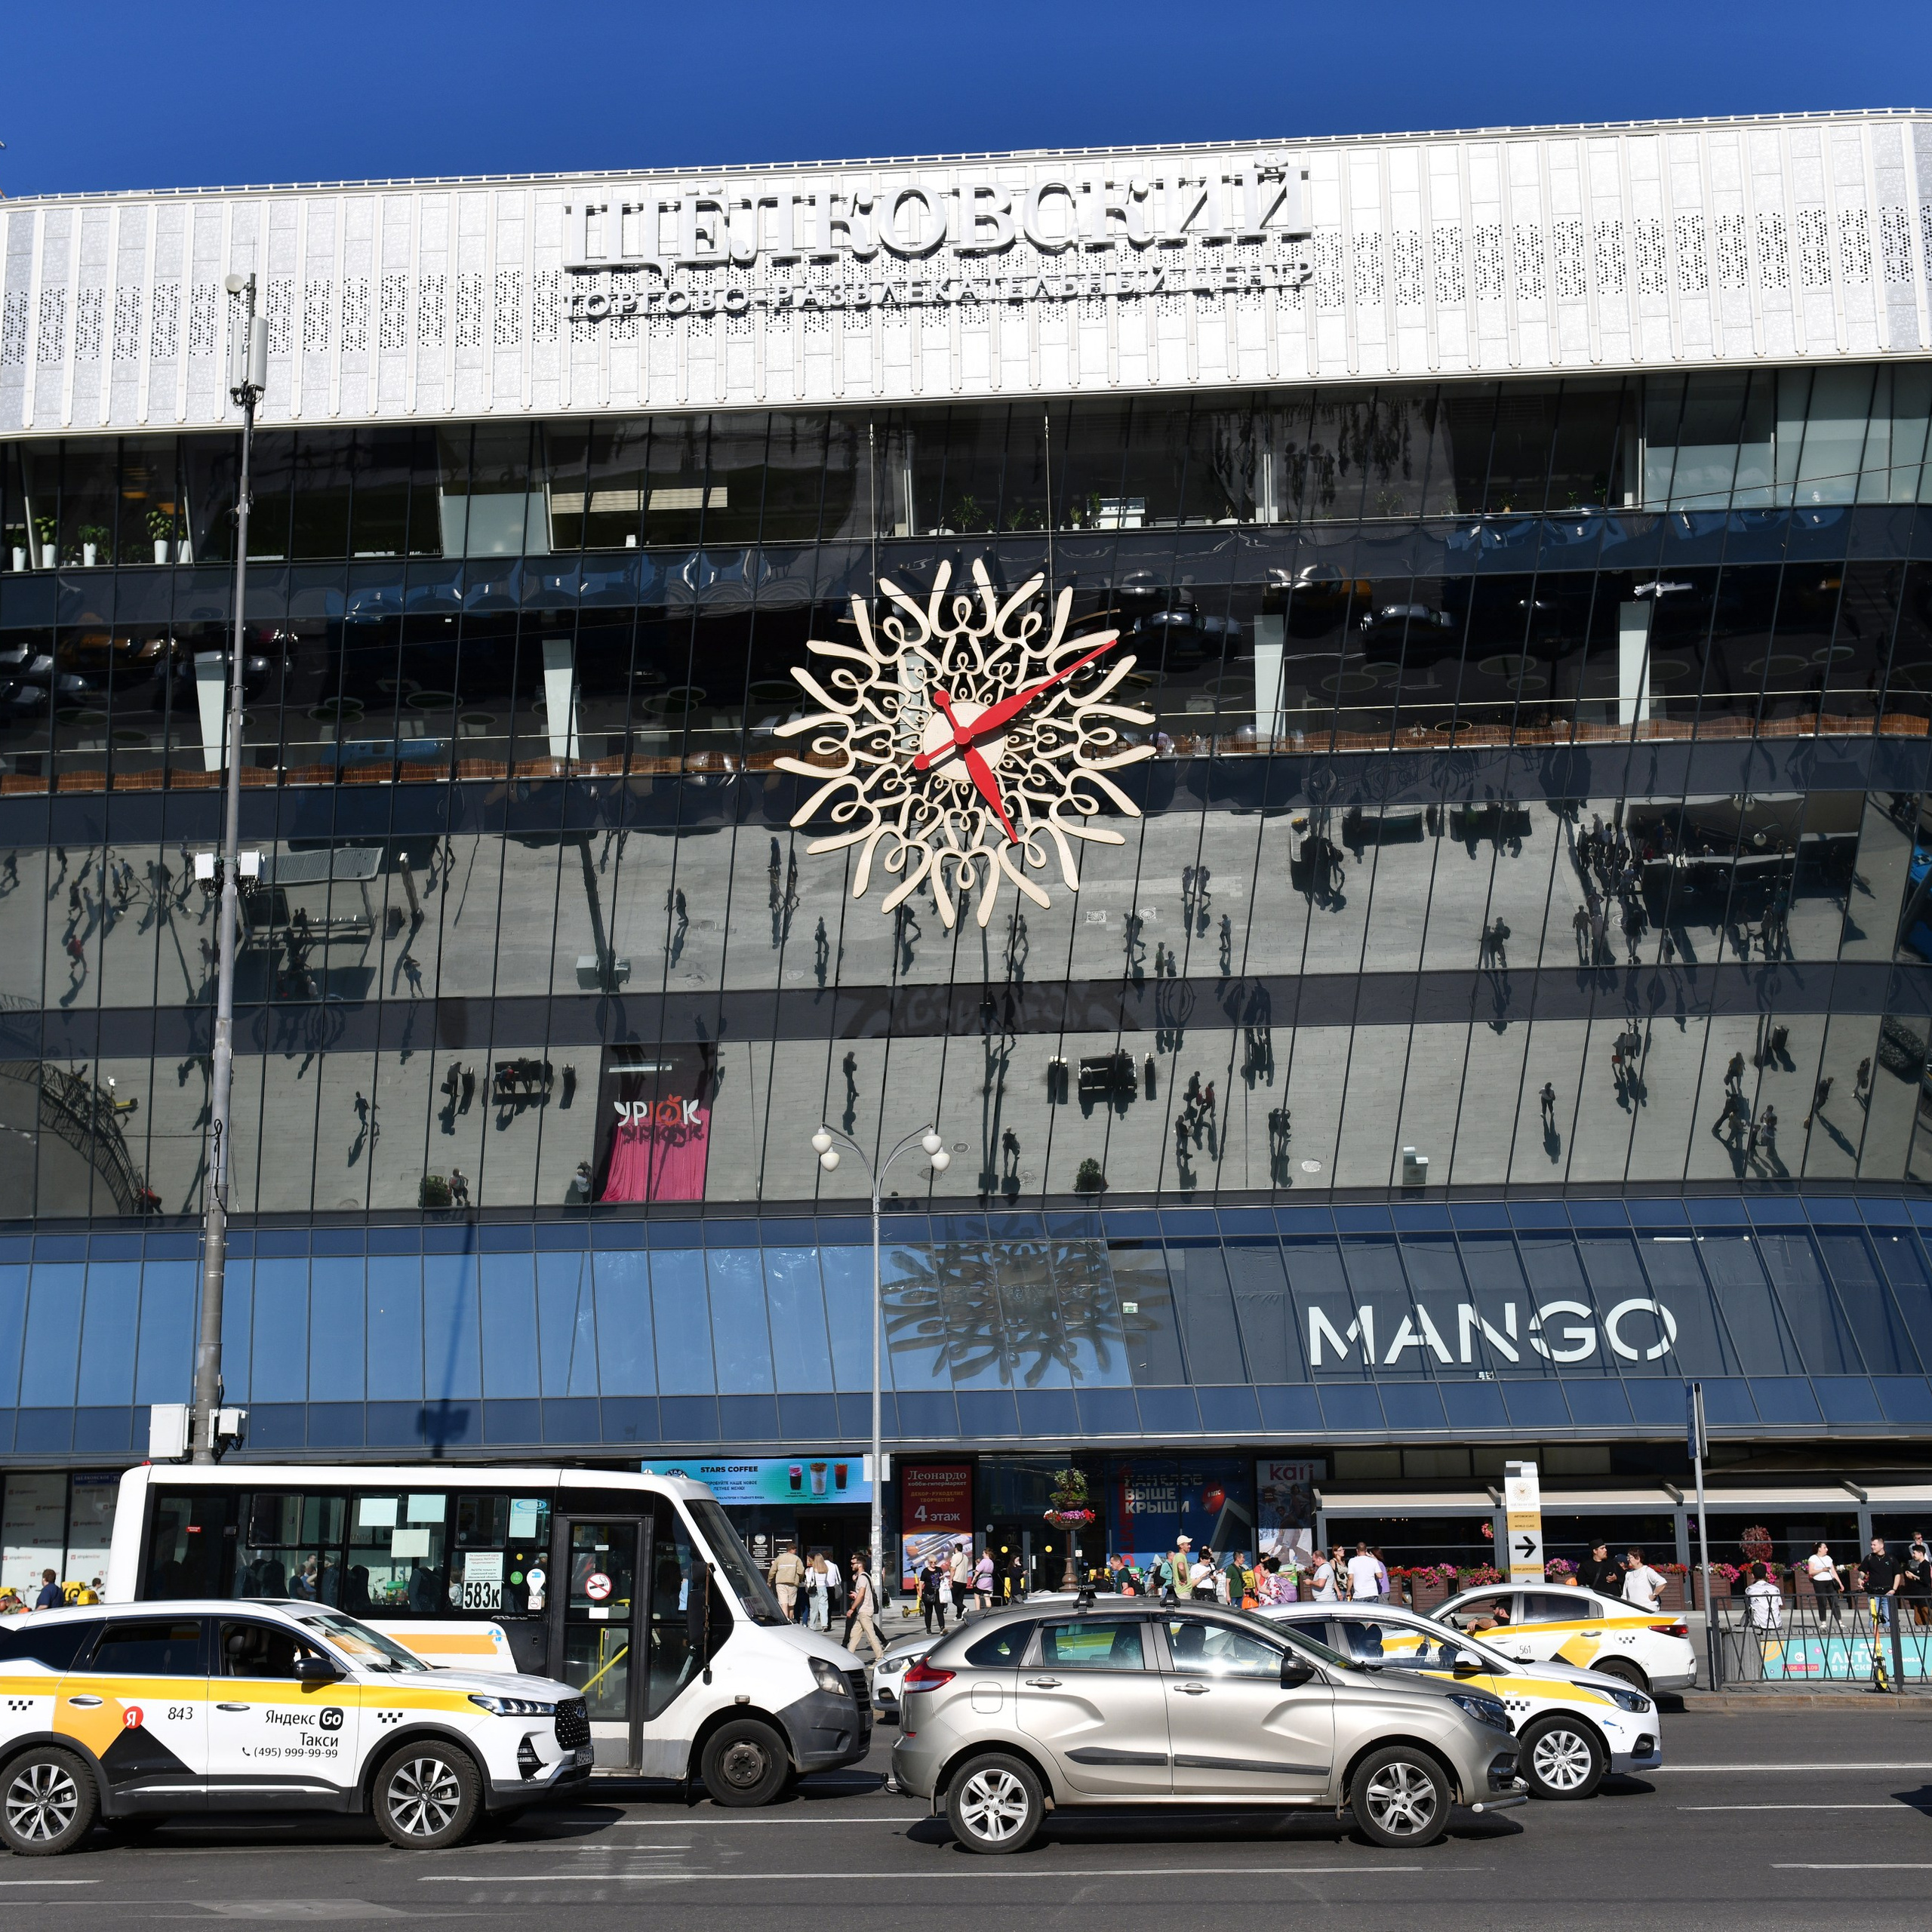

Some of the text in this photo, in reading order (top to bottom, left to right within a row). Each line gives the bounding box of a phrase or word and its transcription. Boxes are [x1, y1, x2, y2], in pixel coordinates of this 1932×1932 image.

[562, 150, 1312, 281] ЩЁЛКОВСКИЙ
[565, 260, 1314, 320] ТОРГОВО-РАЗВЛЕКАТЕЛЬНЫЙ ЦЕНТР
[1308, 1298, 1677, 1365] MANGO
[728, 1465, 758, 1473] COFFEE
[908, 1470, 967, 1481] Леонардо
[1269, 1463, 1314, 1481] kari
[1124, 1487, 1176, 1500] ВЫШЕ
[914, 1506, 961, 1521] 4 этаж
[1125, 1500, 1189, 1514] КРЫШИ
[464, 1582, 500, 1608] 583к
[1519, 1645, 1531, 1654] 561
[125, 1711, 137, 1726] Я
[168, 1706, 193, 1721] 843
[265, 1709, 343, 1727] Яндекс Go
[300, 1732, 339, 1748] Такси
[254, 1746, 338, 1758] (495) 999-99-99
